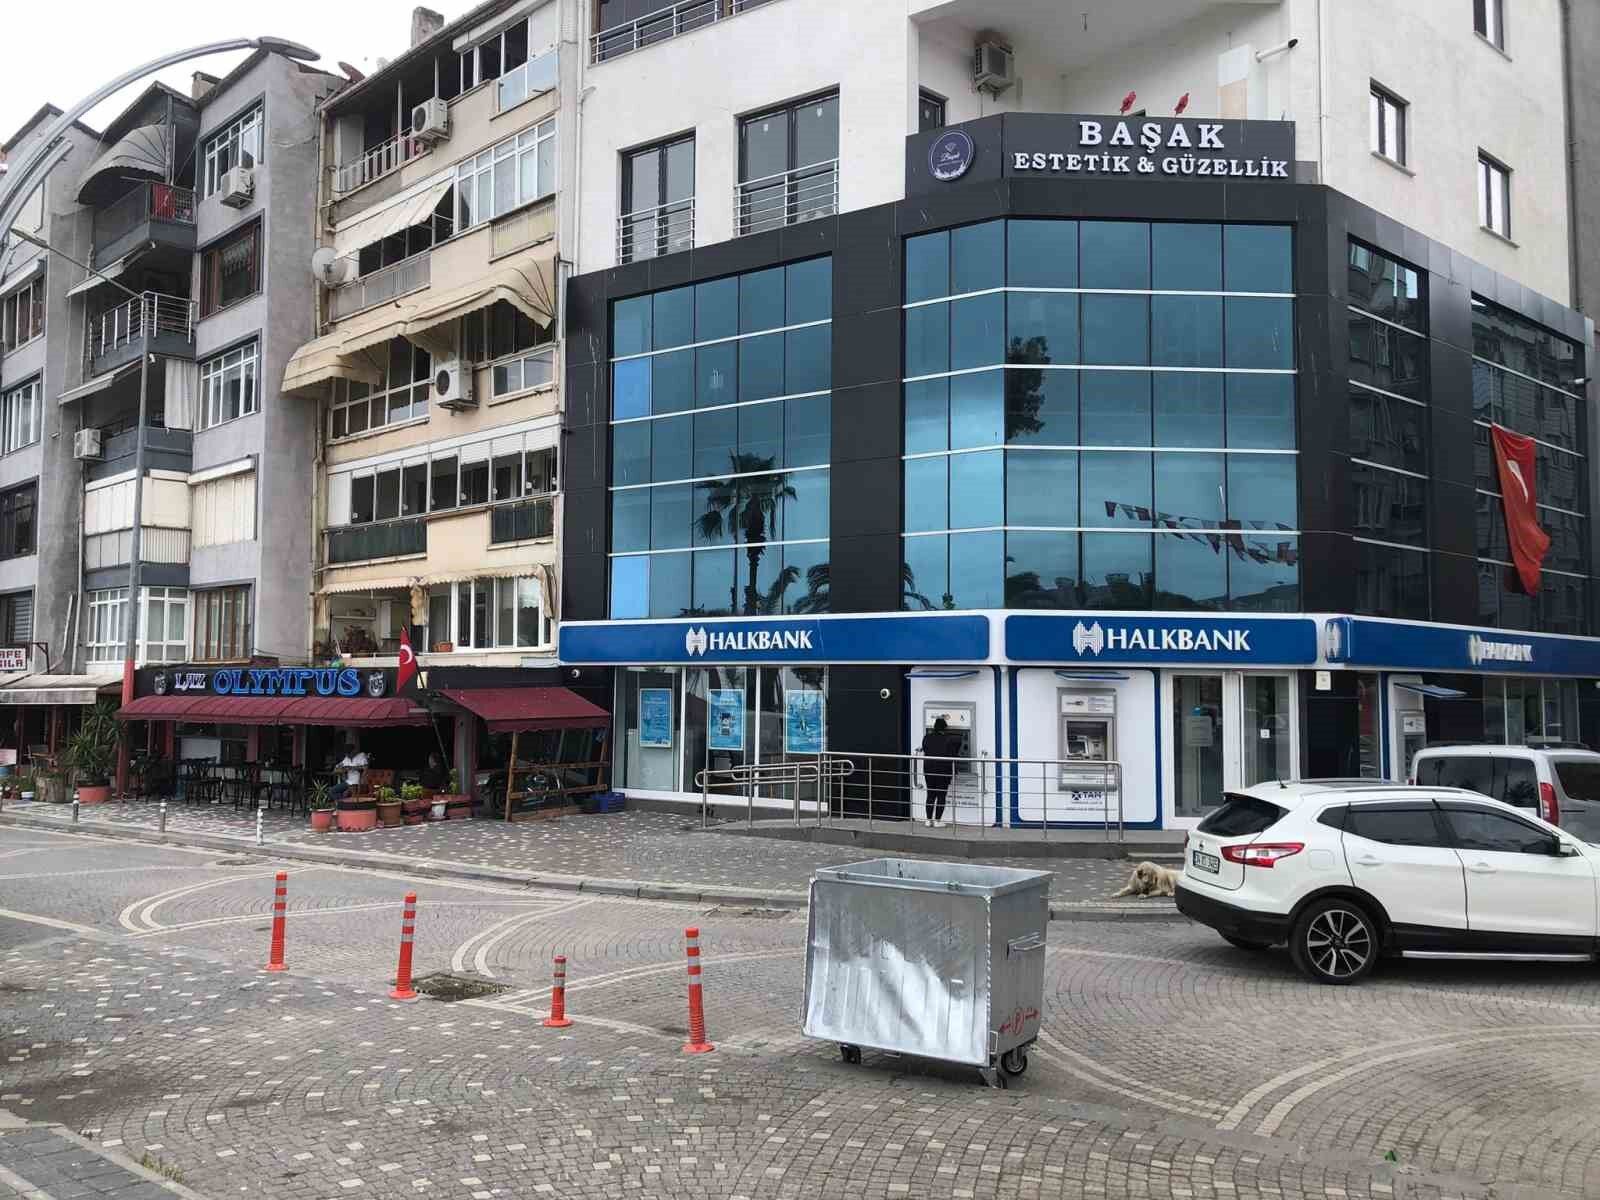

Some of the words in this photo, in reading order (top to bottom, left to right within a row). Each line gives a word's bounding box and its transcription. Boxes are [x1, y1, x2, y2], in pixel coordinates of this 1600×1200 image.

[1079, 121, 1225, 153] BAŞAK
[1014, 151, 1131, 174] ESTETİK
[1137, 155, 1155, 174] &
[1162, 153, 1290, 178] GÜZELLİK
[710, 630, 813, 650] HALKBANK
[1108, 629, 1251, 651] HALKBANK
[212, 668, 361, 696] OLYMPUS
